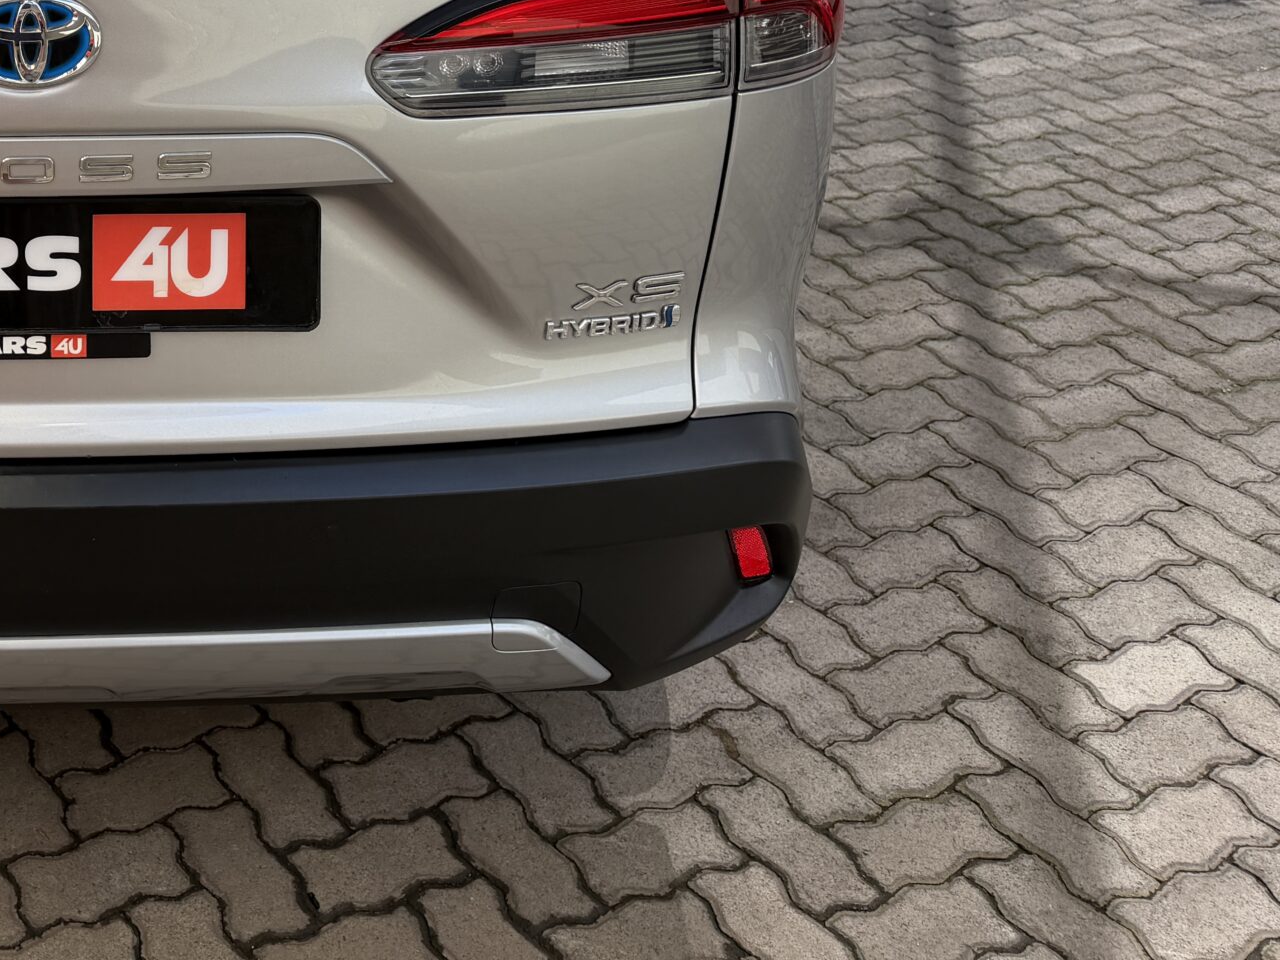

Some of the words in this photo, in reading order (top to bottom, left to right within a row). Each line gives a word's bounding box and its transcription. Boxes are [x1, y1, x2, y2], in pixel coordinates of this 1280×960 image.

[110, 226, 229, 298] 4U
[572, 271, 685, 311] XS
[545, 311, 659, 340] HYBRID
[54, 337, 83, 355] 4U
